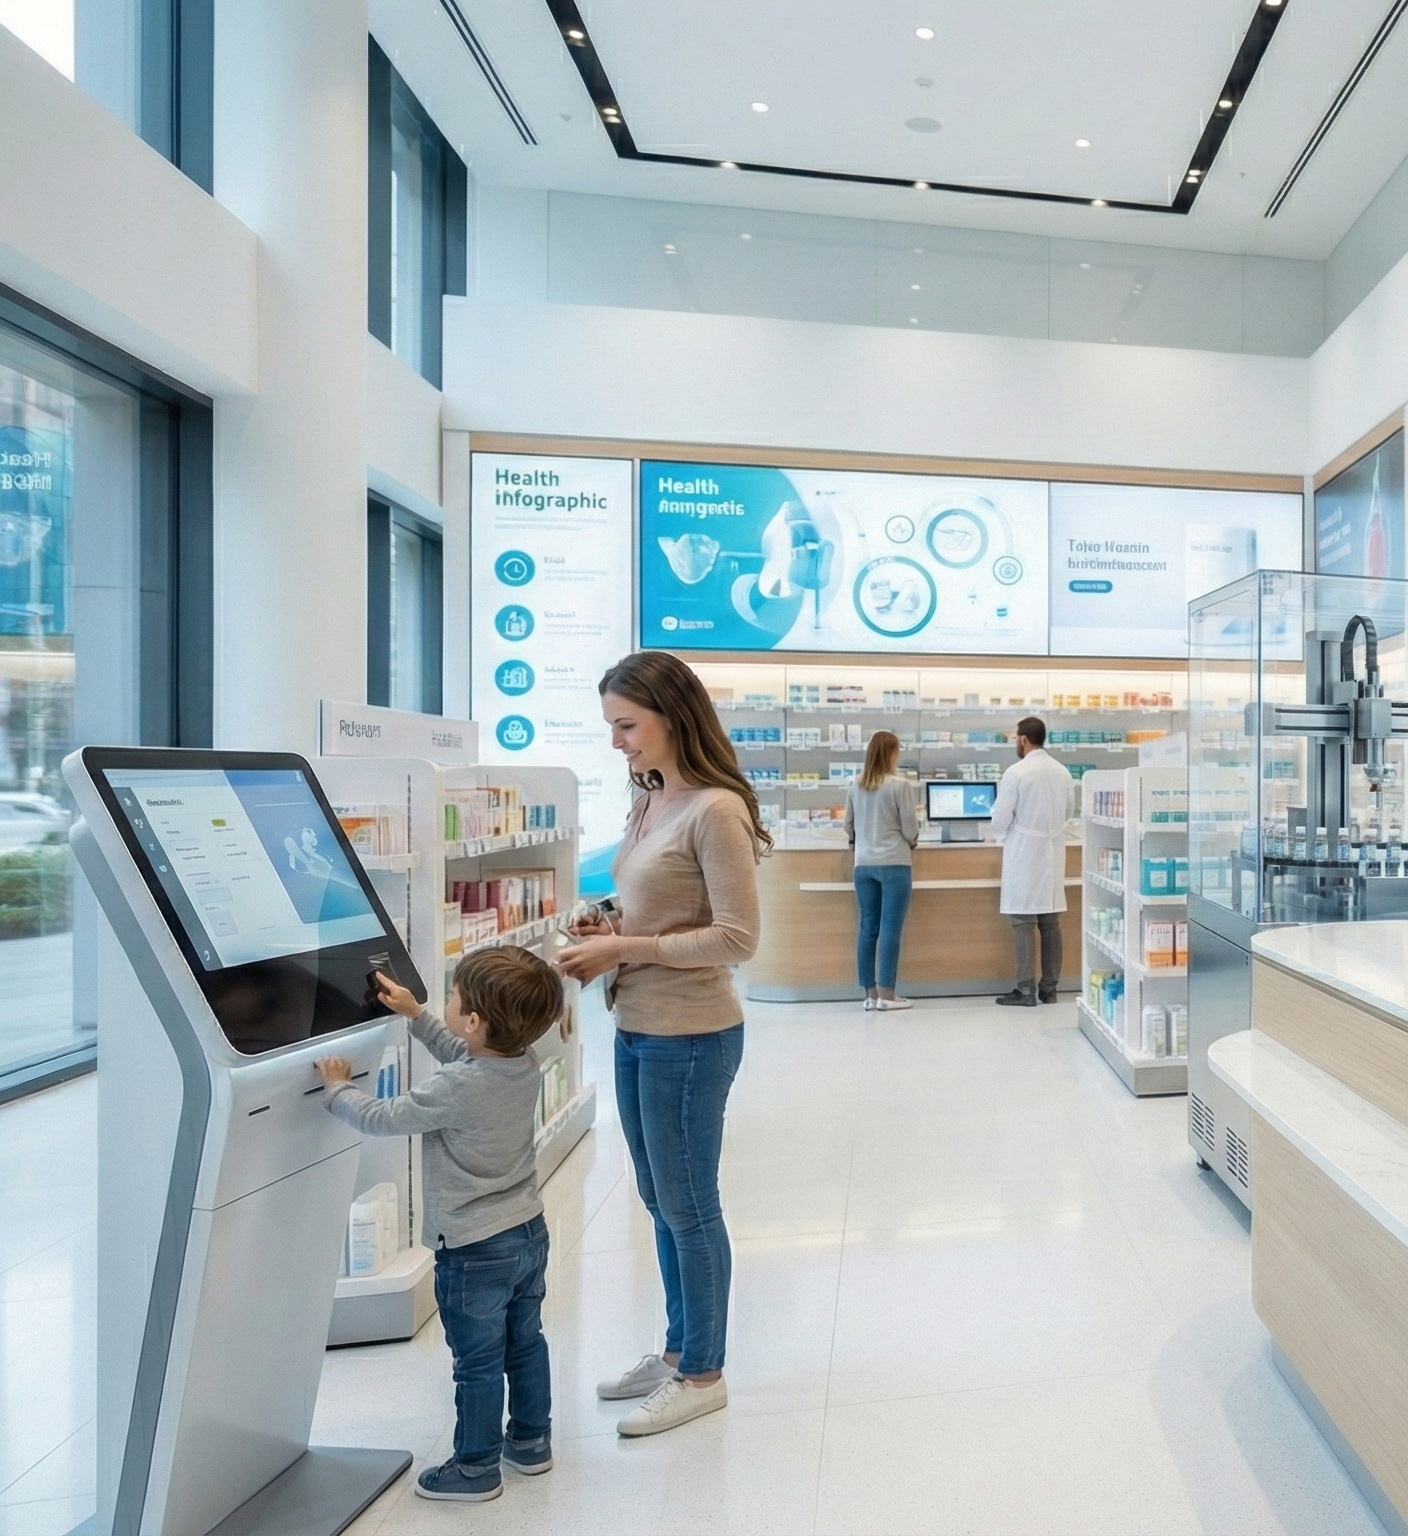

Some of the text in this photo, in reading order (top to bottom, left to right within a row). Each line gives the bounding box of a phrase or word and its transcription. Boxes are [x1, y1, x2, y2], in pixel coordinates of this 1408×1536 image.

[495, 468, 560, 487] Health
[658, 477, 720, 495] Health
[495, 488, 608, 513] infographic
